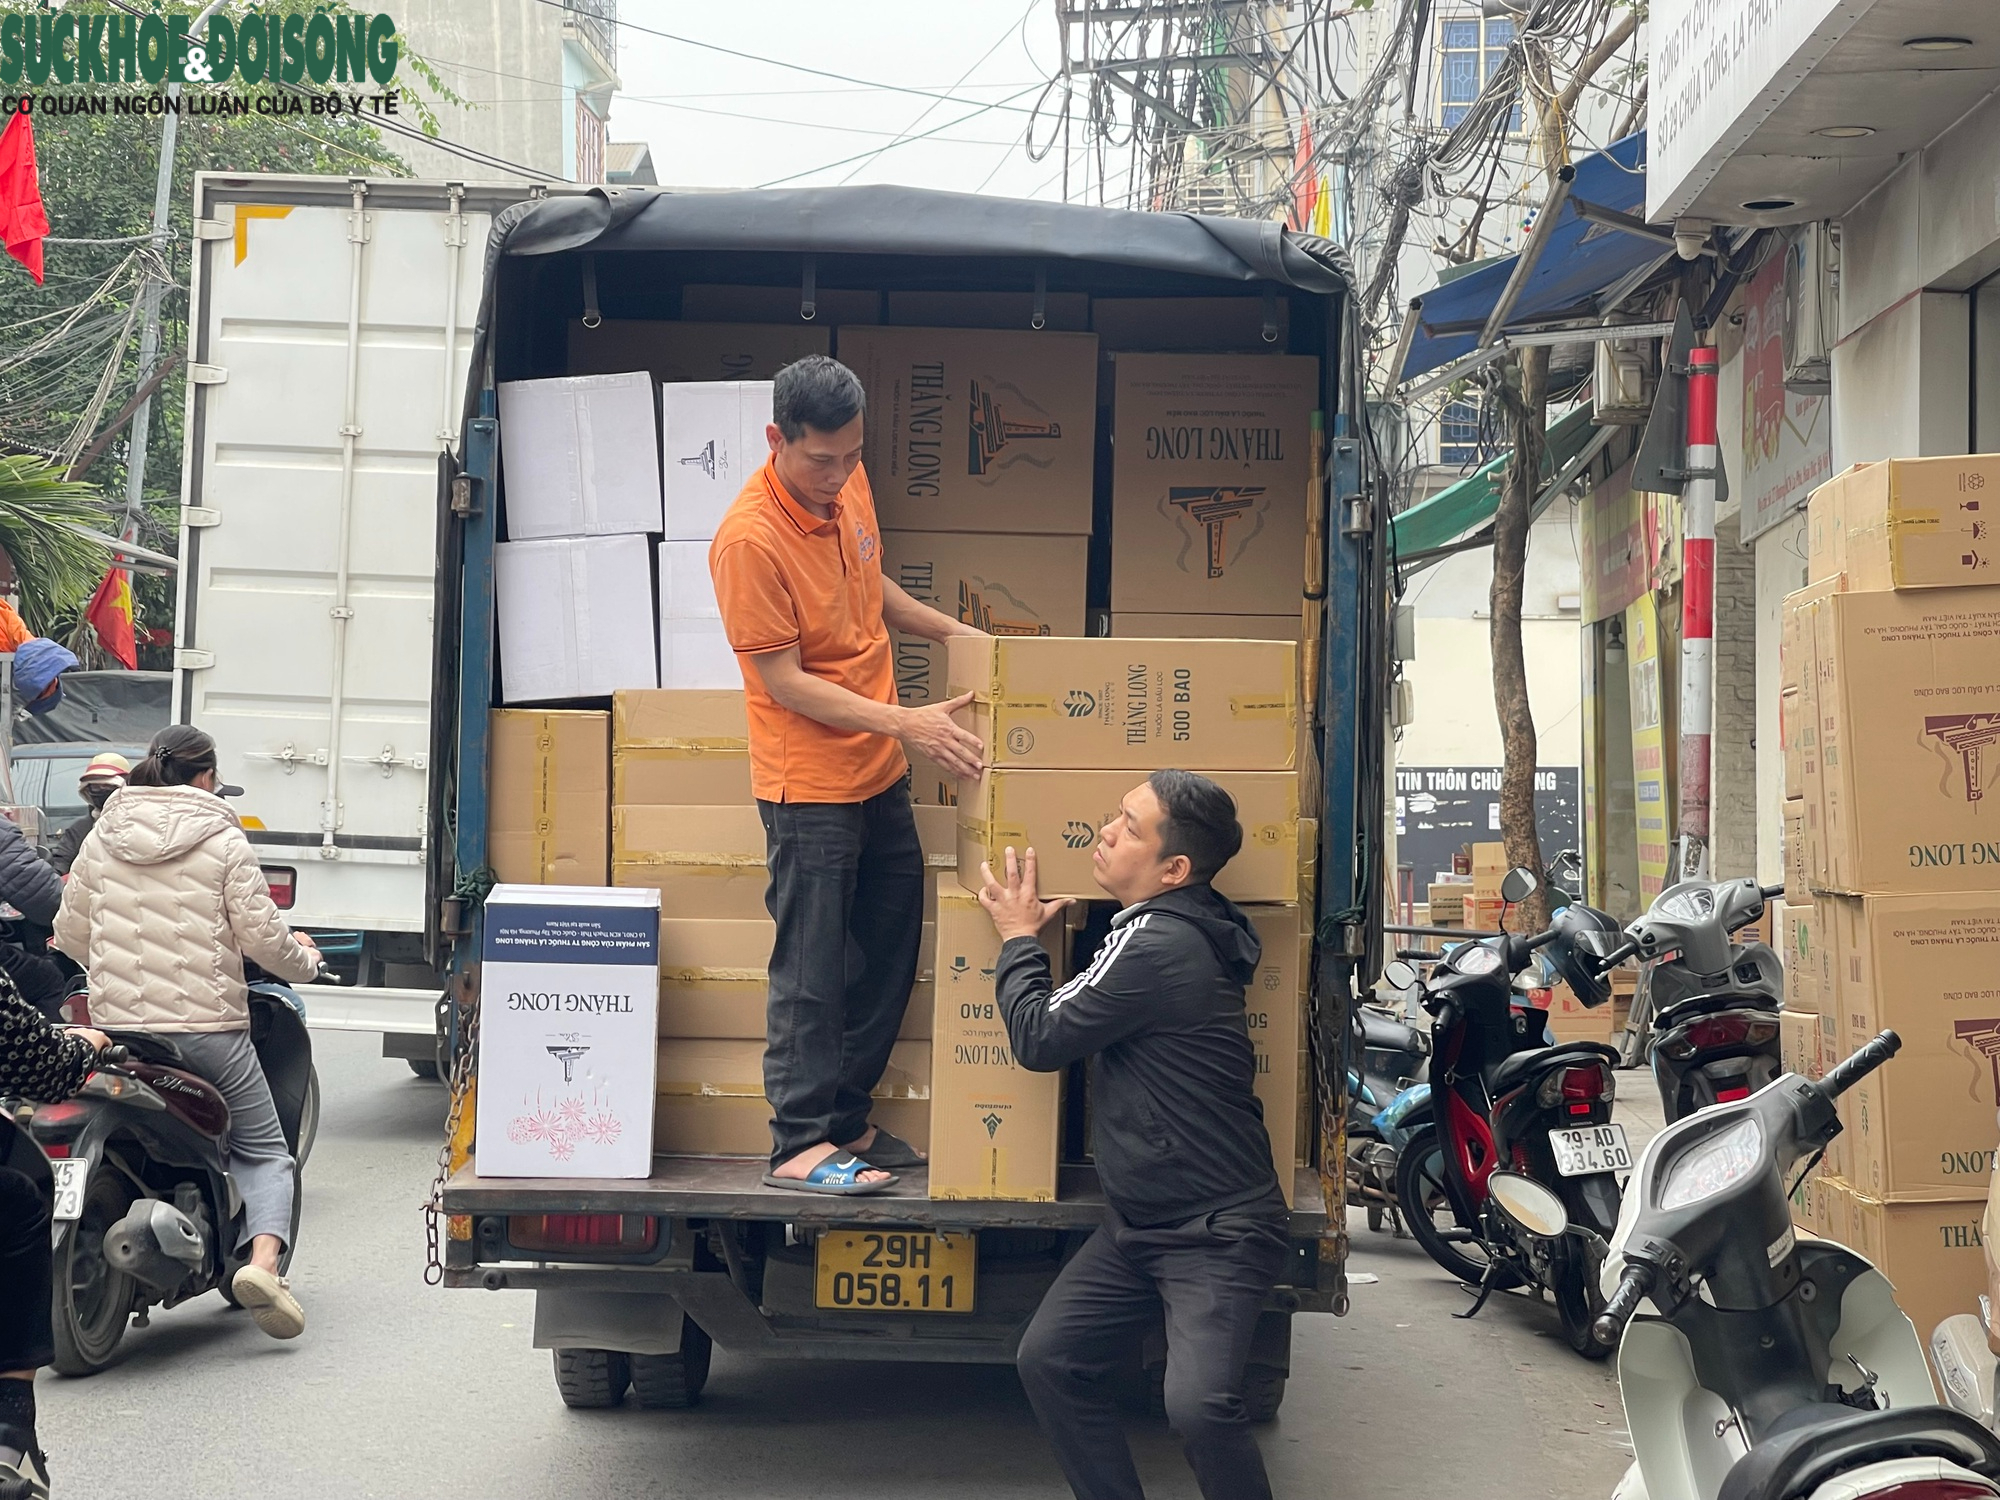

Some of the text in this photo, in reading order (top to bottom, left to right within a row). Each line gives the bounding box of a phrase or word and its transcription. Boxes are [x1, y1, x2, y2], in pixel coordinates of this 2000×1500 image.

[1681, 10, 1691, 57] TY
[1657, 96, 1668, 158] SỐ
[1669, 101, 1678, 143] 29
[1679, 66, 1701, 129] CHÙA
[1732, 11, 1745, 61] LA
[907, 361, 953, 497] THĂNG LONG
[1146, 426, 1284, 469] THĂNG LONG
[897, 643, 931, 700] LONG
[1935, 687, 1950, 695] BAO
[1122, 663, 1148, 746] THĂNG LONG
[1155, 671, 1164, 738] THUỐC LÁ ĐẦU LỌC
[1173, 669, 1191, 742] 500 BAO
[1016, 734, 1024, 748] ISO
[1427, 768, 1467, 791] THÔN
[1471, 768, 1502, 791] CHÙ
[1535, 772, 1557, 791] NG
[1909, 842, 1966, 869] LONG
[548, 938, 571, 947] THUỐC
[581, 939, 600, 947] CÔNG
[600, 939, 615, 948] CỦA
[615, 940, 636, 949] PHẨM
[636, 941, 651, 949] SẢN
[1966, 936, 1989, 944] THUỐC
[507, 992, 634, 1016] THĂNG LONG
[1964, 991, 1979, 999] BAO
[960, 1003, 994, 1019] BAO
[1248, 1012, 1268, 1029] 50
[955, 1044, 989, 1065] LONG
[1561, 1128, 1615, 1150] 29-AD
[1560, 1147, 1627, 1172] 334.60
[1941, 1151, 1996, 1174] LONG
[822, 1173, 849, 1185] NIKE
[1940, 1217, 1983, 1248] THĂ
[862, 1234, 931, 1268] 29H
[833, 1272, 954, 1308] 058.11
